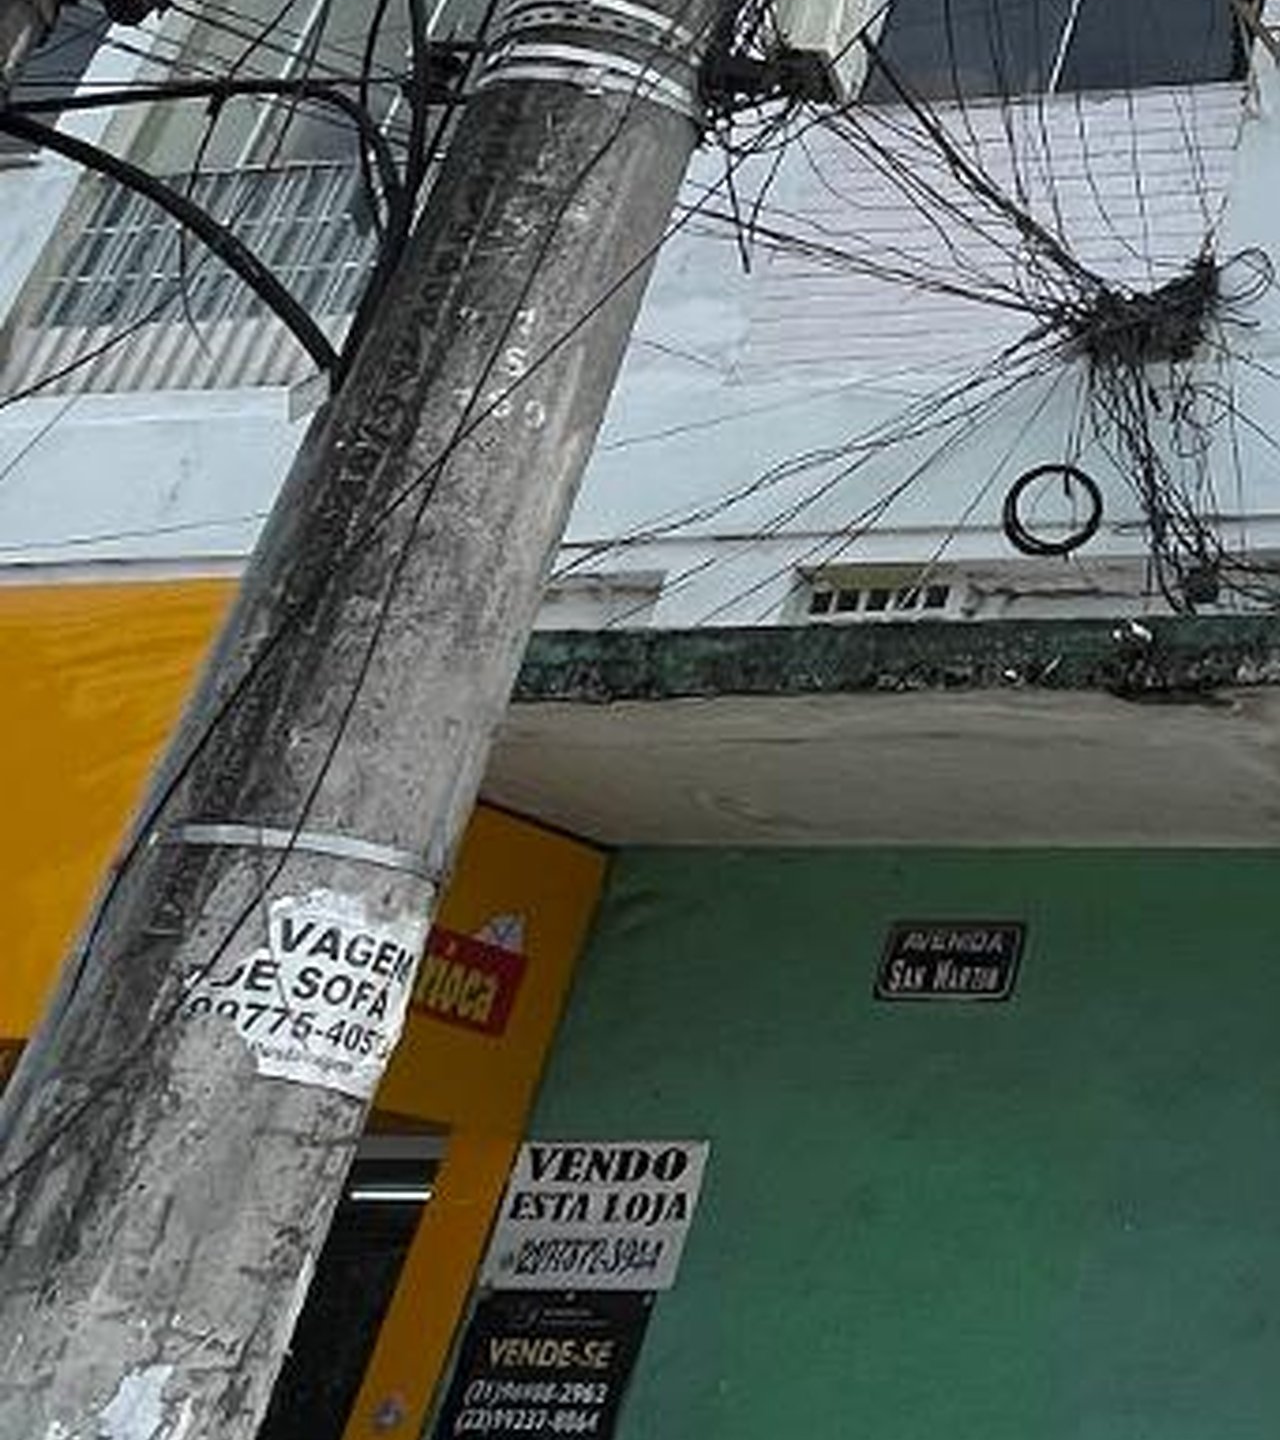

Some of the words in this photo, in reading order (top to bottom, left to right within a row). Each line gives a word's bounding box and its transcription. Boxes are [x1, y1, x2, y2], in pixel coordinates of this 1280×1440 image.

[528, 1146, 688, 1183] VENDO
[508, 1192, 590, 1222] ESTA
[602, 1192, 687, 1227] LOJA
[488, 1338, 614, 1369] VENDE-SE
